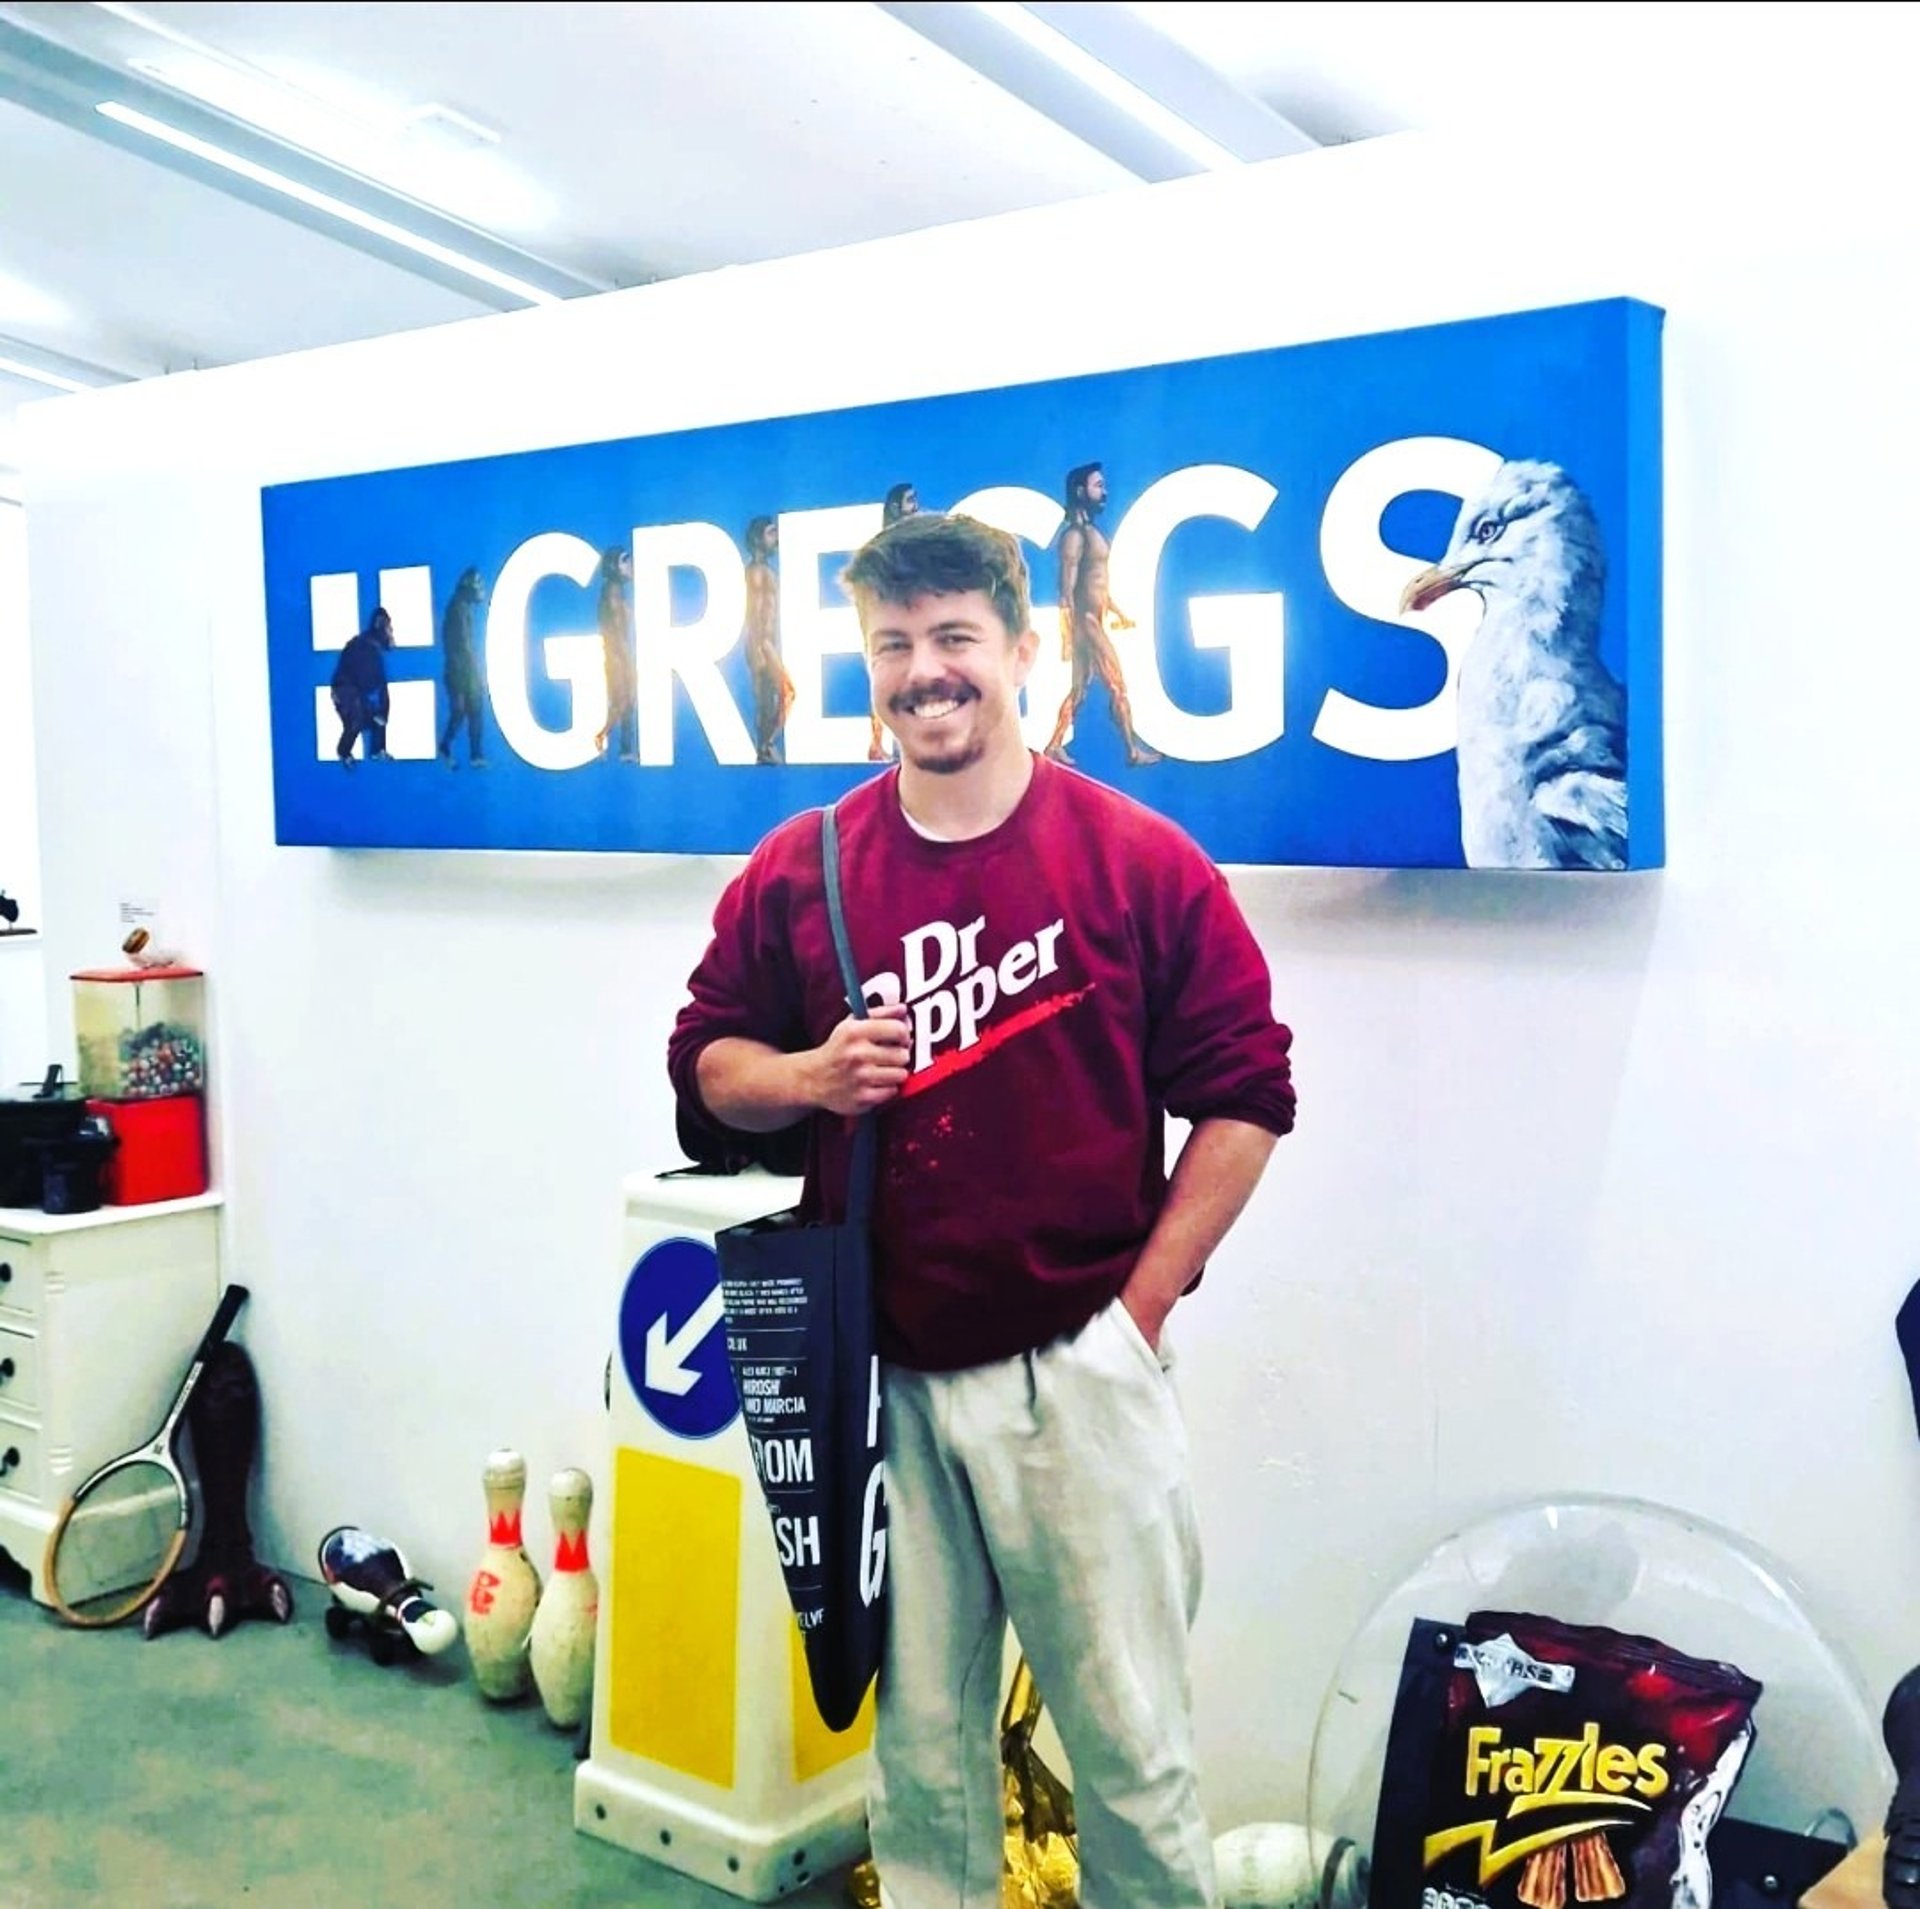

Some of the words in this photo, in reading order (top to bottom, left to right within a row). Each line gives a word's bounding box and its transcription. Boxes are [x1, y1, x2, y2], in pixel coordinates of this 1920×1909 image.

[845, 918, 1064, 1074] pper
[901, 915, 986, 1003] Dr
[763, 1396, 806, 1414] MARCIA
[1465, 1721, 1671, 1799] Frazzles
